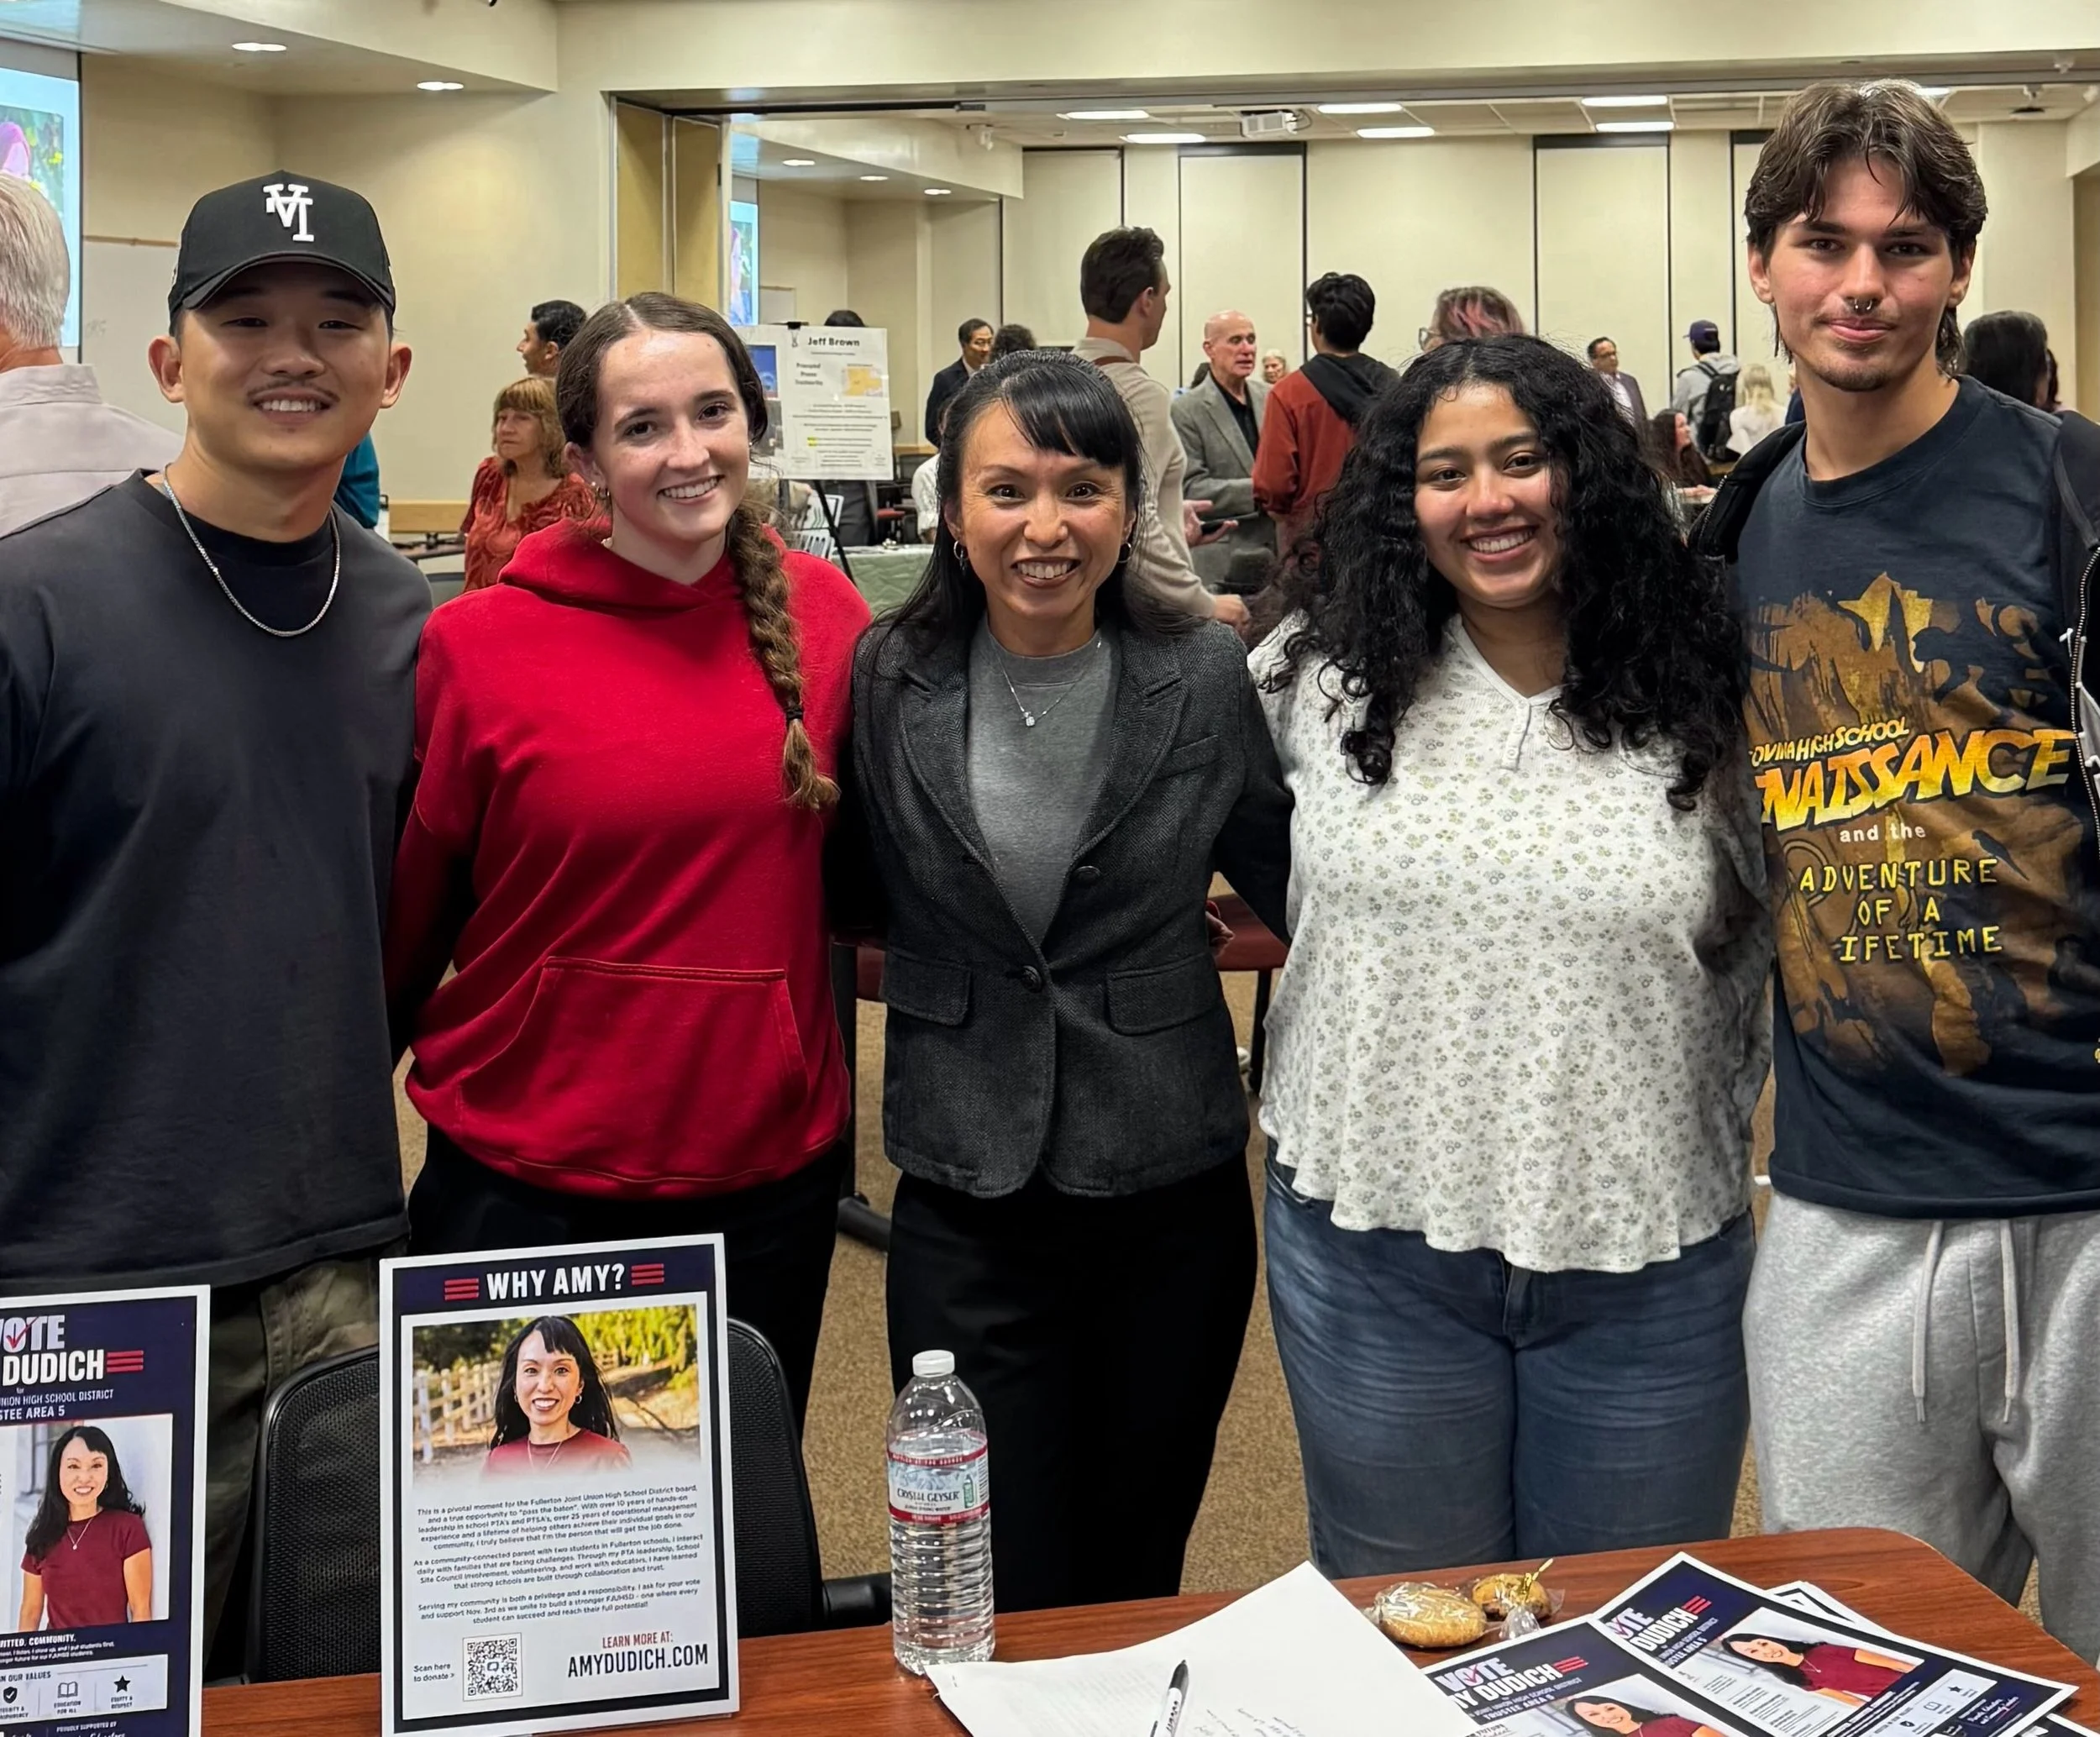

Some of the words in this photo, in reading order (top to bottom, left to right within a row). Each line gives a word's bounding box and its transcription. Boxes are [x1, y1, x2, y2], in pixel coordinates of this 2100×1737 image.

[807, 337, 827, 346] Jeff
[828, 337, 860, 347] Brown
[1795, 732, 1835, 762] HIGH
[1835, 716, 1909, 749] SCHOOL
[1840, 824, 1879, 843] and
[1889, 822, 1926, 840] the
[1799, 858, 1998, 893] ADVENTURE
[1857, 899, 1893, 926] OF
[1924, 896, 1940, 922] A
[486, 1269, 546, 1300] WHY
[553, 1262, 625, 1295] AMY?
[0, 1315, 66, 1353] OTE
[3, 1349, 104, 1387] DUDICH
[23, 1394, 43, 1405] HIGH
[45, 1391, 76, 1404] SCHOOL
[78, 1388, 114, 1401] DISTRICT
[26, 1405, 55, 1419] AREA
[58, 1405, 66, 1417] 5
[417, 1508, 432, 1516] This
[446, 1503, 472, 1514] pivotal
[473, 1501, 503, 1510] moment
[529, 1497, 562, 1505] Fullerton
[563, 1494, 581, 1503] Joint
[582, 1493, 604, 1501] Union
[604, 1491, 622, 1499] High
[622, 1488, 647, 1498] School
[648, 1486, 674, 1495] District
[465, 1510, 507, 1520] opportunity
[626, 1498, 645, 1507] years
[417, 1524, 455, 1533] leadership
[465, 1520, 489, 1530] school
[581, 1511, 600, 1519] years
[610, 1506, 651, 1516] operational
[652, 1502, 697, 1512] management
[420, 1533, 460, 1542] experience
[572, 1520, 600, 1529] achieve
[618, 1514, 654, 1524] individual
[654, 1513, 674, 1522] goals
[511, 1548, 536, 1558] parent
[569, 1543, 600, 1552] students
[609, 1540, 642, 1548] Fullerton
[675, 1533, 703, 1542] interact
[567, 1530, 593, 1538] person
[593, 1527, 608, 1535] that
[419, 1573, 434, 1584] Site
[435, 1573, 463, 1582] Council
[670, 1551, 697, 1560] learned
[482, 1561, 497, 1569] that
[576, 1551, 606, 1560] Through
[675, 1541, 700, 1551] School
[470, 1580, 494, 1588] strong
[494, 1577, 522, 1586] schools
[536, 1573, 553, 1582] built
[554, 1571, 583, 1580] through
[583, 1567, 630, 1577] collaboration
[417, 1602, 445, 1611] Serving
[459, 1597, 500, 1607] community
[508, 1594, 527, 1603] both
[533, 1592, 565, 1601] privilege
[667, 1580, 683, 1588] your
[435, 1609, 465, 1619] support
[548, 1599, 567, 1608] build
[574, 1597, 605, 1605] stronger
[655, 1589, 677, 1598] where
[472, 1614, 500, 1624] student
[516, 1610, 545, 1619] succeed
[561, 1607, 582, 1615] reach
[583, 1605, 600, 1614] their
[601, 1603, 613, 1612] full
[29, 1634, 77, 1646] COMMUNITY.
[602, 1635, 631, 1649] LEARN
[633, 1632, 658, 1645] MORE
[660, 1630, 674, 1644] AT:
[1630, 1607, 1698, 1651] DUDICH
[413, 1664, 433, 1672] Scan
[433, 1662, 451, 1671] here
[568, 1644, 708, 1678] AMYDUDICH.COM
[1434, 1657, 1515, 1692] VOTE
[25, 1671, 51, 1681] VALUES
[423, 1673, 449, 1682] donate
[1474, 1663, 1564, 1702] DUDICH
[1528, 1686, 1555, 1698] SCHOOL
[1483, 1705, 1524, 1720] TRUSTEE
[1523, 1698, 1546, 1708] AREA
[1545, 1693, 1555, 1702] 5
